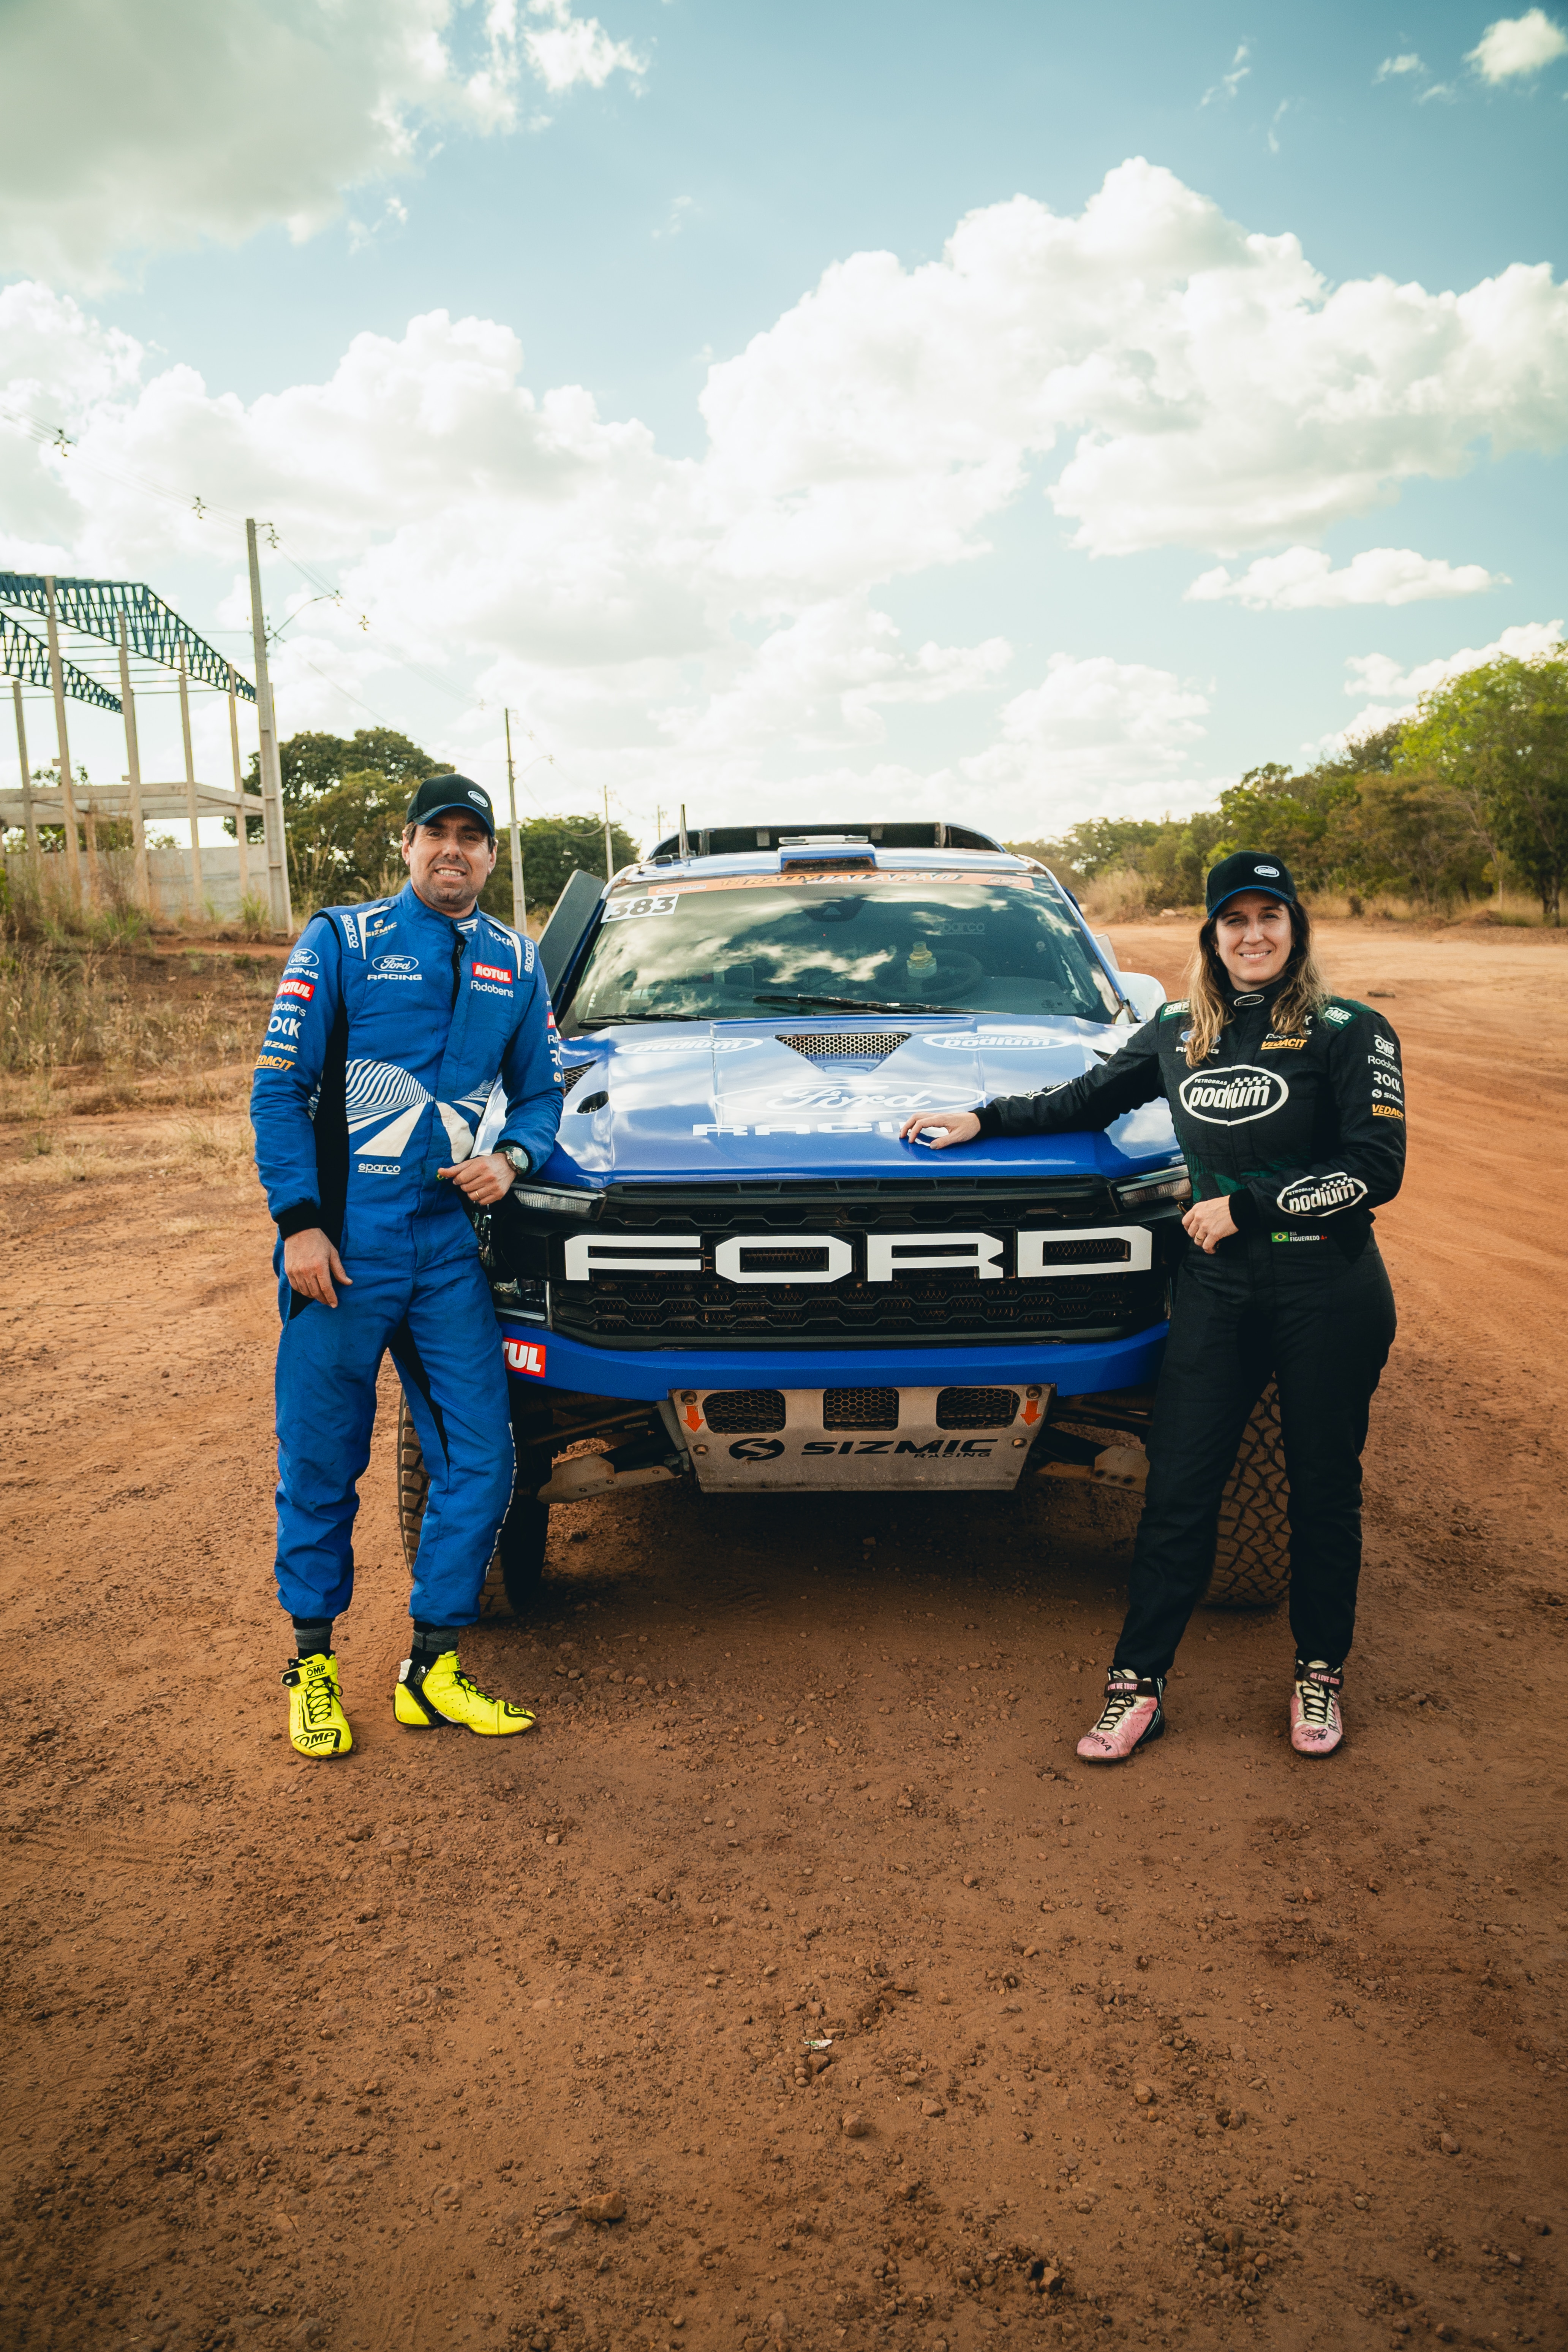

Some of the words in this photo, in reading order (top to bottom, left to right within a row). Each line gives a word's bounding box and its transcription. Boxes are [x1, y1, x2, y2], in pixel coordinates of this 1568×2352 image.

[606, 896, 676, 919] 383
[341, 914, 359, 948] sparco
[365, 922, 397, 937] SIZMIC
[291, 951, 312, 964] Ford
[380, 957, 411, 970] Ford
[524, 939, 534, 973] sparco
[475, 964, 511, 982] MOTUL
[278, 981, 310, 998] MOTUL
[471, 980, 514, 998] Rodobens
[1165, 1001, 1190, 1012] OMP
[1325, 1009, 1349, 1021] OMP
[263, 1040, 298, 1053] SIZMIC
[632, 1040, 743, 1052] podium
[943, 1037, 1051, 1047] podium
[1261, 1038, 1307, 1048] VEDACIT
[1375, 1038, 1394, 1056] OMP
[1367, 1055, 1402, 1076] Rodobens
[1373, 1071, 1401, 1094] ROCK
[765, 1085, 933, 1111] Ford
[1189, 1084, 1270, 1109] podium
[358, 1163, 401, 1173] sparco
[1287, 1186, 1314, 1196] PETROBRAS
[1289, 1183, 1356, 1212] podium
[564, 1226, 1152, 1283] FORD
[801, 1438, 999, 1455] SIZMIC
[307, 1665, 326, 1676] OMP
[1318, 1674, 1330, 1683] LOVE
[299, 1732, 335, 1747] OMP
